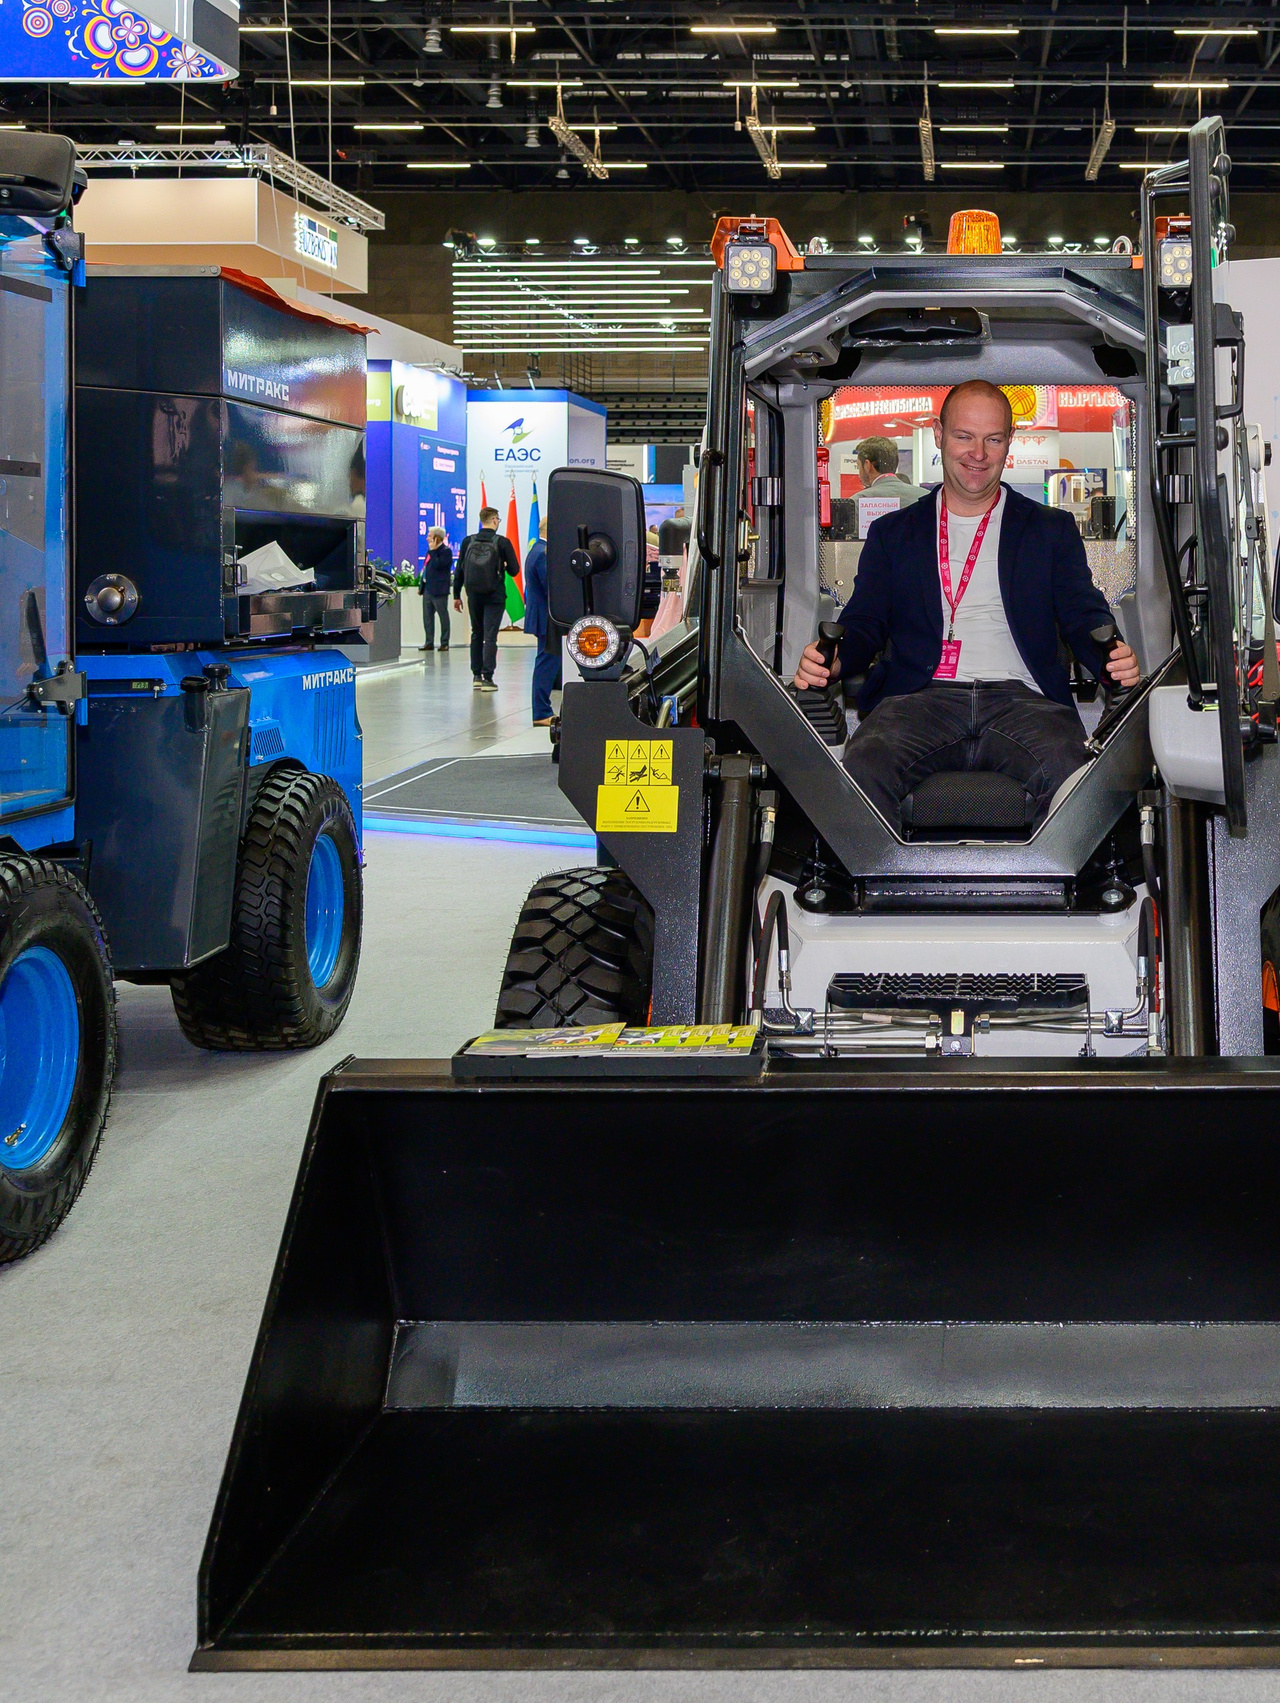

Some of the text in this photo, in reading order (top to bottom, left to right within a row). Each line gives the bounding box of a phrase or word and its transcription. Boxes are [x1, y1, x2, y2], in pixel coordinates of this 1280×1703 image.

[226, 368, 290, 402] МИТРАКС
[494, 448, 541, 462] ЕАЭС
[302, 667, 354, 691] МИТРАКС
